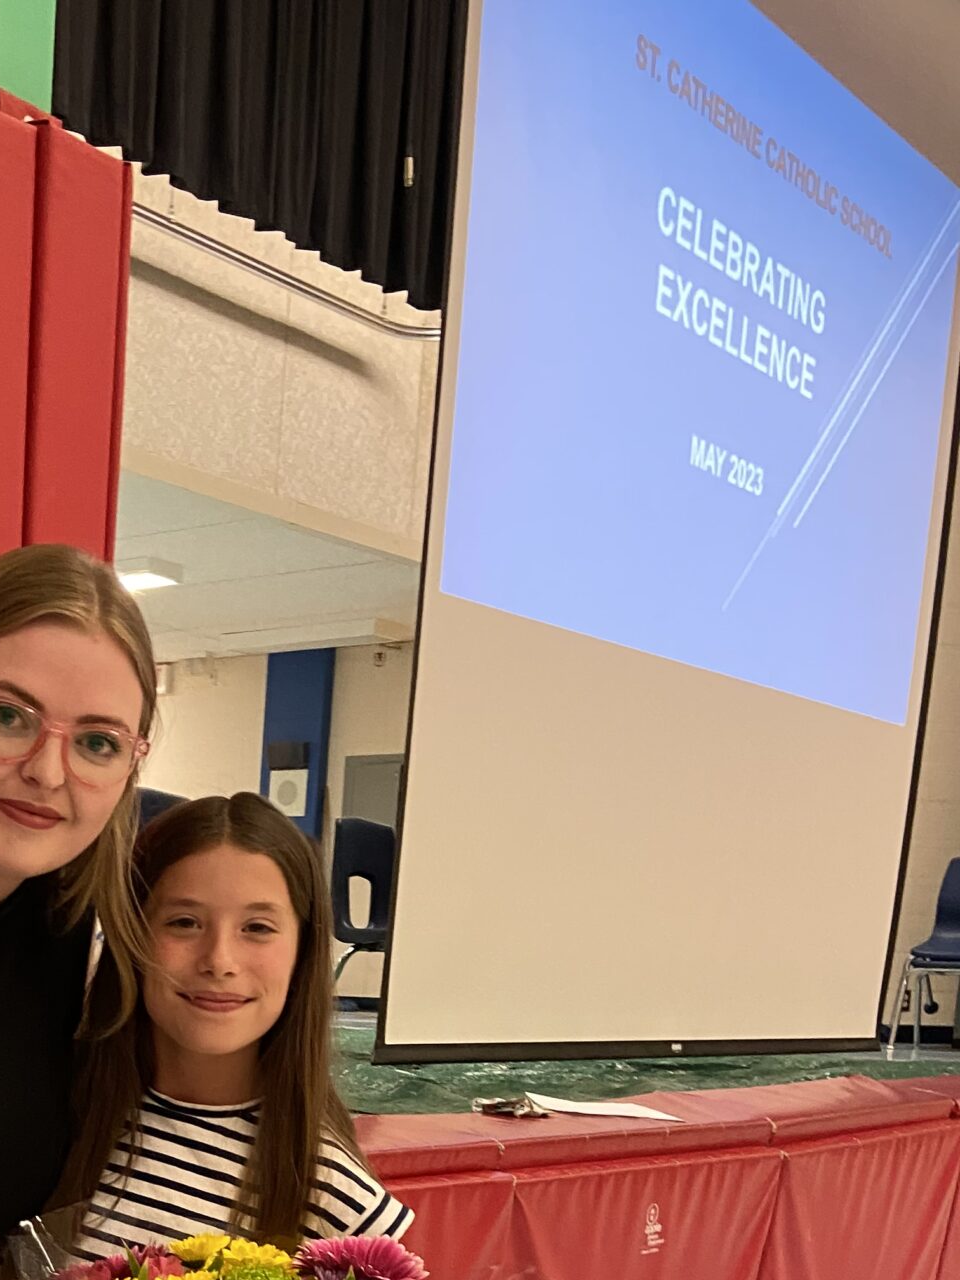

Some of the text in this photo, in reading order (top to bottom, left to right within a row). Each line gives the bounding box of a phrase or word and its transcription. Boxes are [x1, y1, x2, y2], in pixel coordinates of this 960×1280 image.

[636, 33, 892, 260] ST. CATHERINE CATHOLIC SCHOOL
[657, 186, 826, 335] CELEBRATING
[655, 264, 816, 400] EXCELLENCE
[689, 434, 765, 497] MAY 2023
